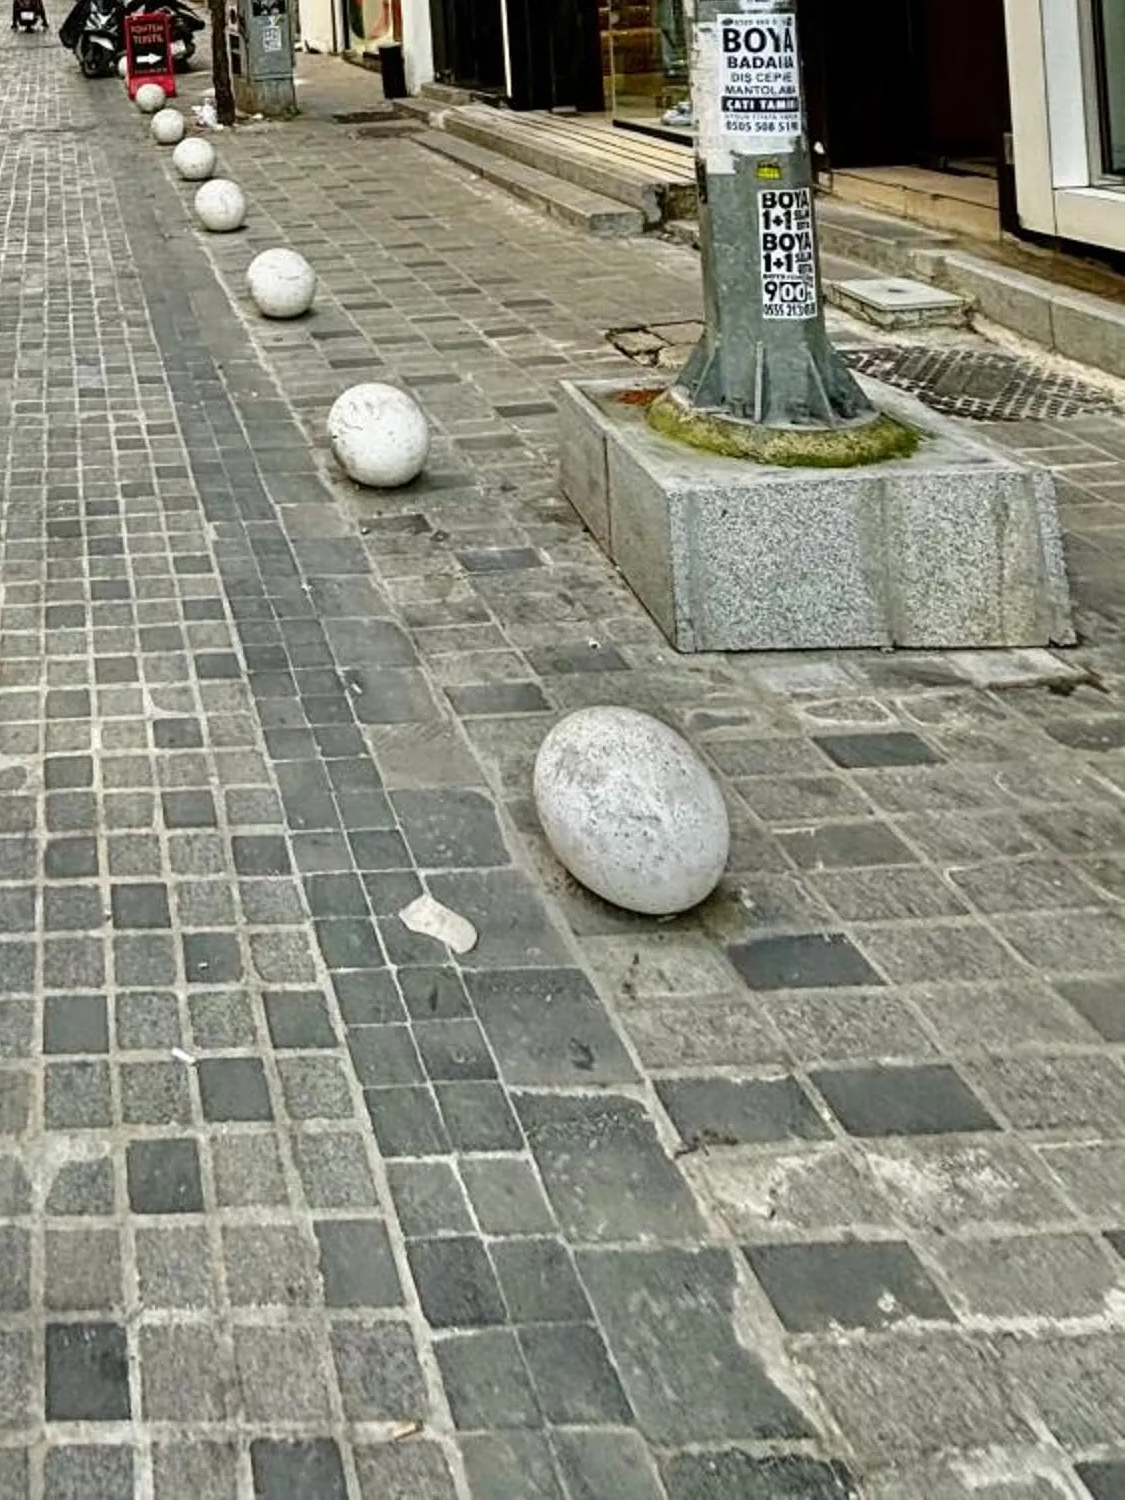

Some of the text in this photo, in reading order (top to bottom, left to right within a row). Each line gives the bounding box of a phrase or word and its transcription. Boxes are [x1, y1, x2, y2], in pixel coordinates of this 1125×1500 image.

[722, 27, 794, 53] BOYA
[762, 189, 809, 209] BOYA
[763, 210, 792, 231] 1+1
[762, 231, 811, 252] BOYA
[763, 252, 793, 273] 1+1
